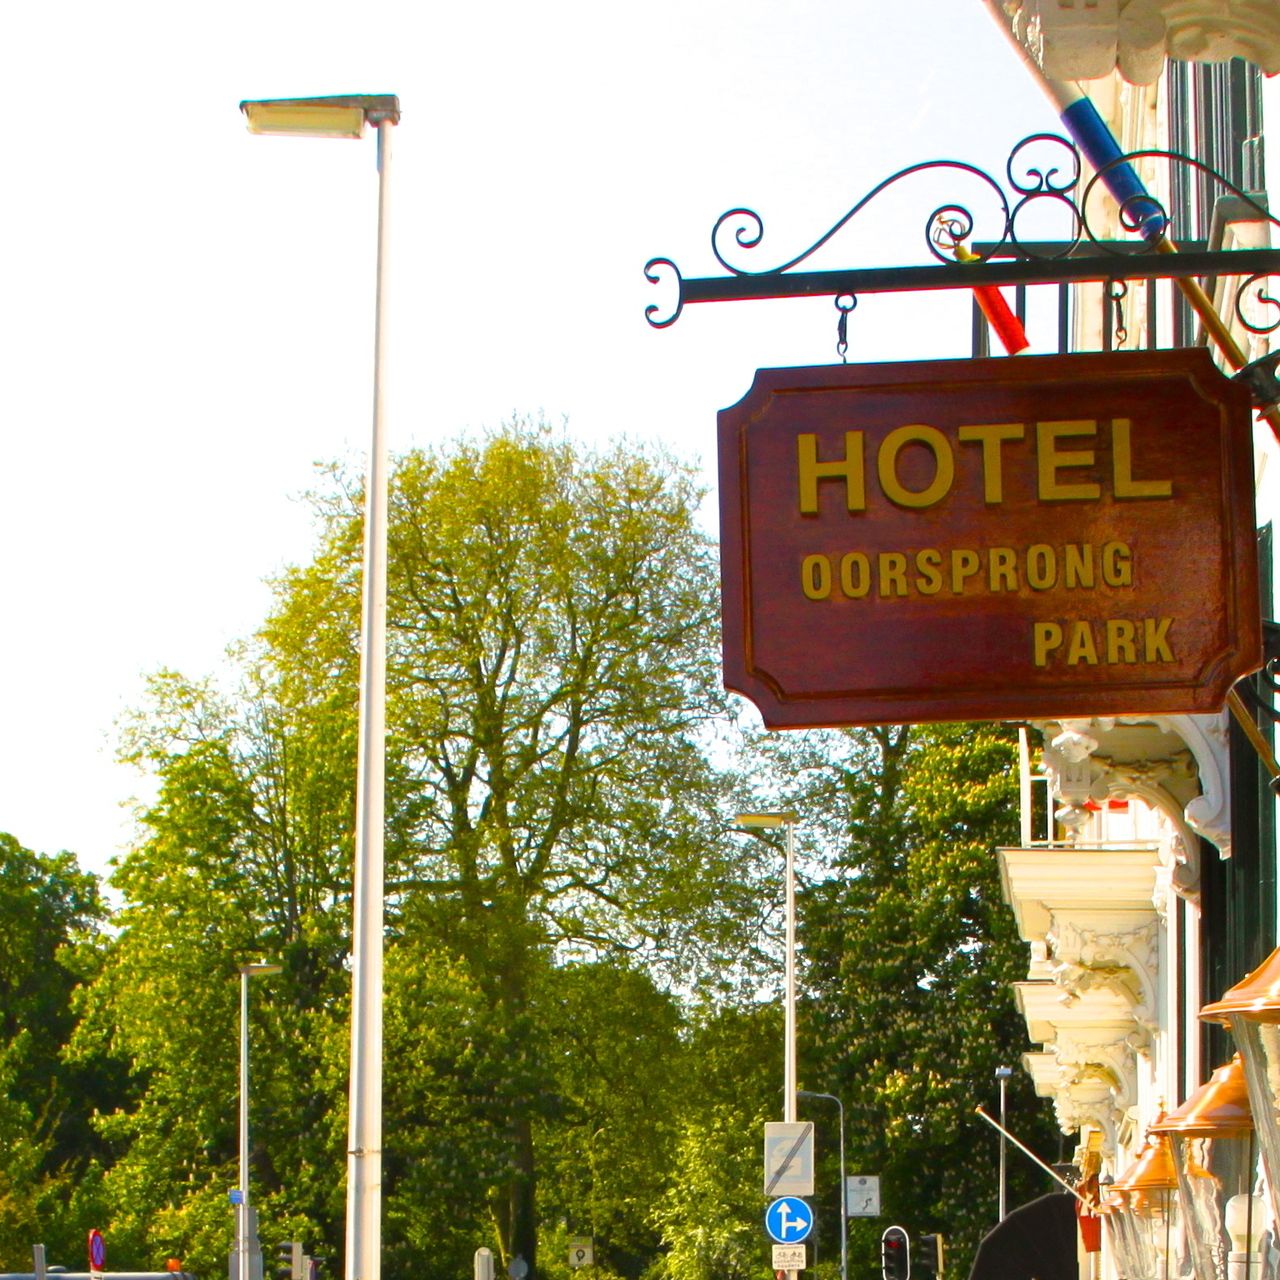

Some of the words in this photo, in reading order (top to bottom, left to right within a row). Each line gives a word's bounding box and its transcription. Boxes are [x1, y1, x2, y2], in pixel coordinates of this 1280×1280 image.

[797, 418, 1173, 514] HOTEL
[801, 542, 1134, 601] OORSPRONG
[1034, 617, 1178, 667] PARK
